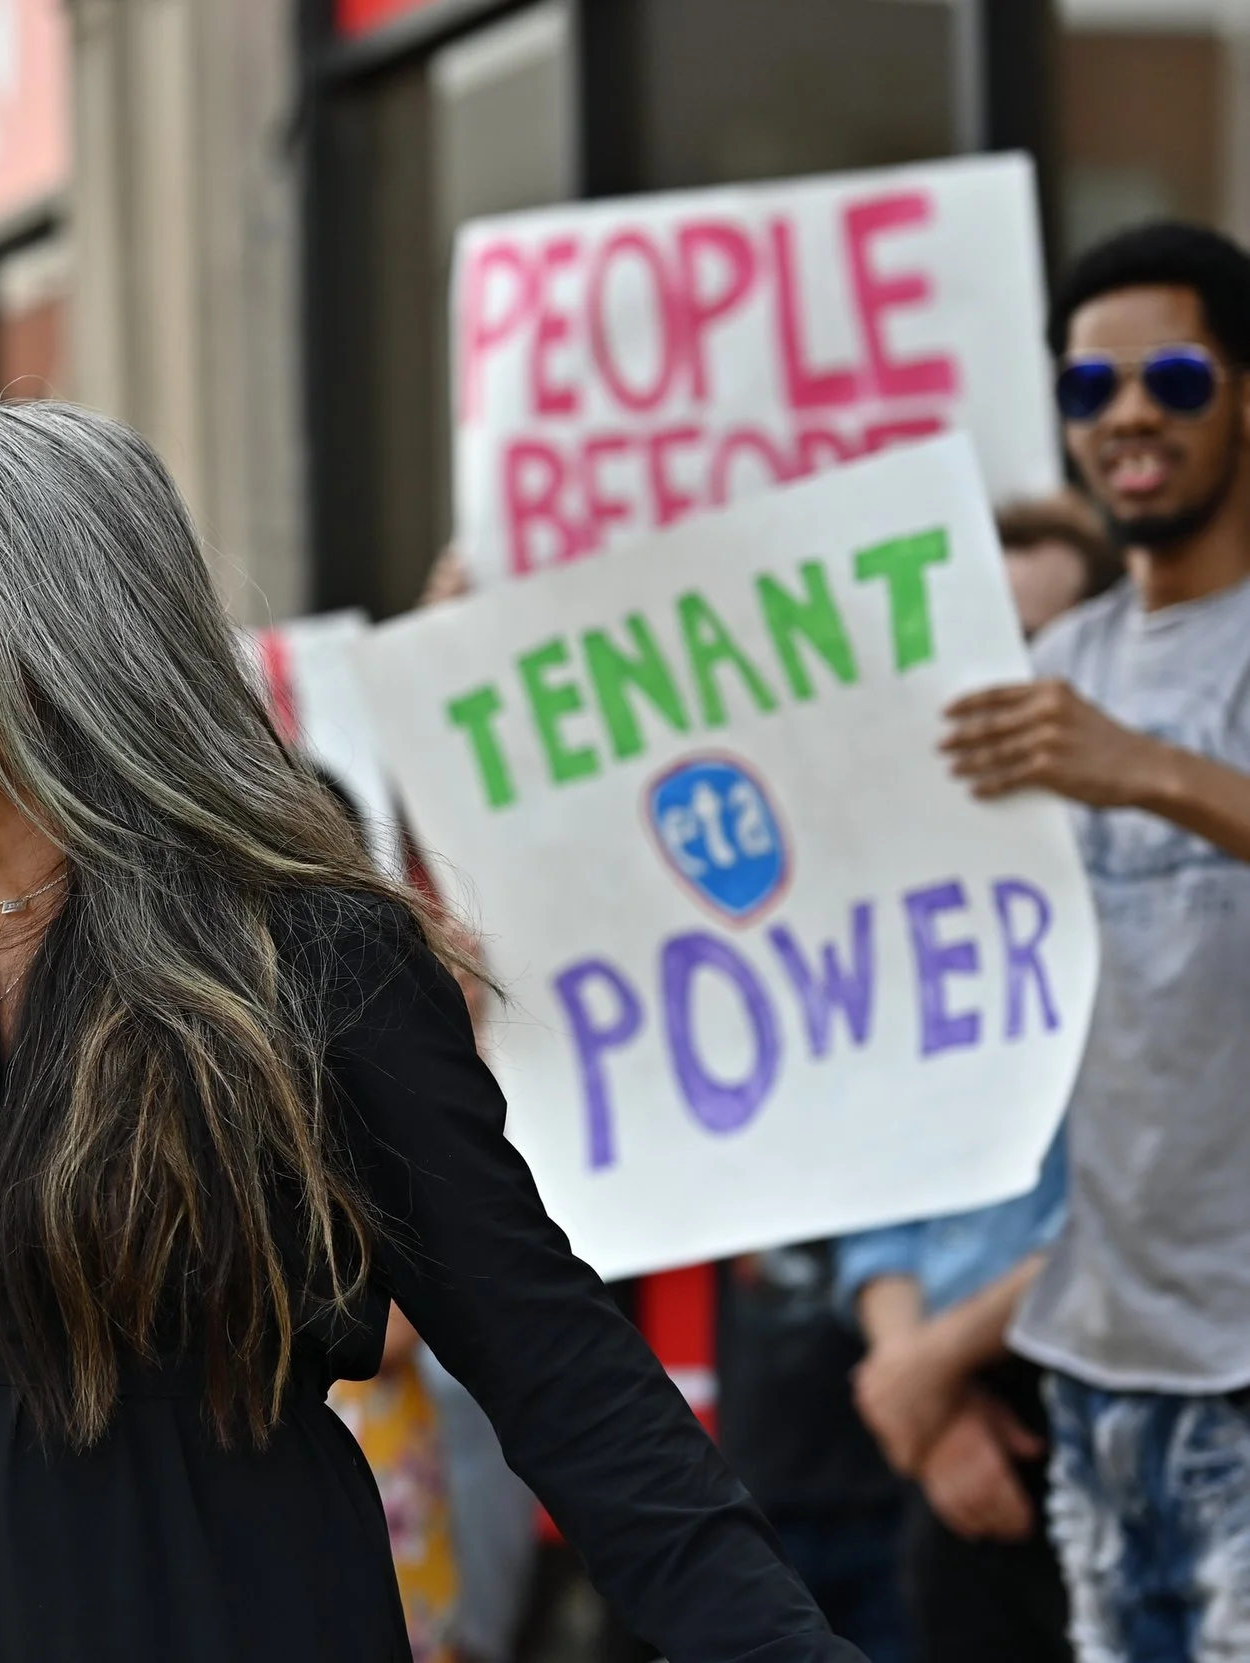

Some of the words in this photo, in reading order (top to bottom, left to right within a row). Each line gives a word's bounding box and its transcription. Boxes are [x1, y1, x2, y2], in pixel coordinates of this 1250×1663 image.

[456, 190, 960, 428] PEOPLE
[504, 416, 944, 578] BEFO
[443, 525, 953, 811] TENANT
[550, 876, 1064, 1174] POWER
